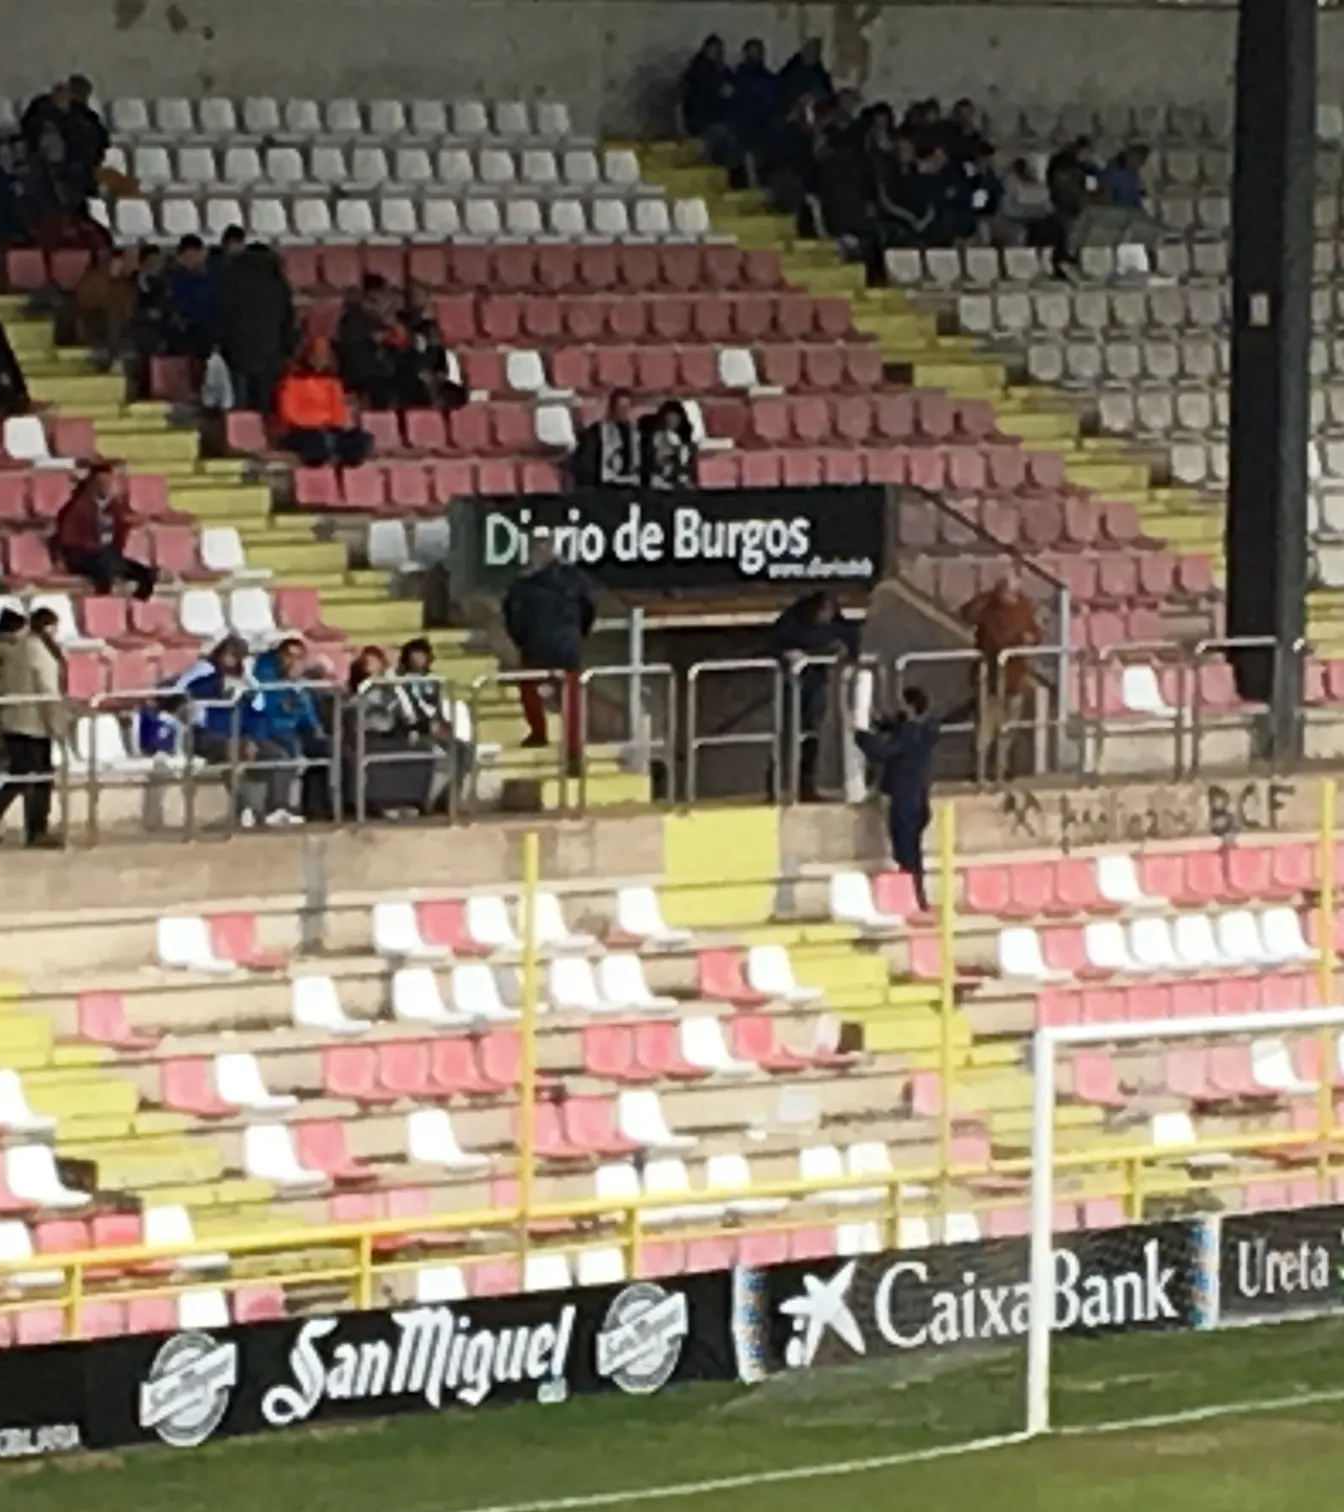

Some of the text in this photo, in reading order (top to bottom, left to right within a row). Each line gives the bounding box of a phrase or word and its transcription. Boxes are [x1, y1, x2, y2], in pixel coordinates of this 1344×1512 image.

[613, 501, 665, 562] de
[673, 507, 811, 576] Burgos
[874, 1238, 1179, 1348] CaixaBank
[1238, 1235, 1331, 1298] Ureta
